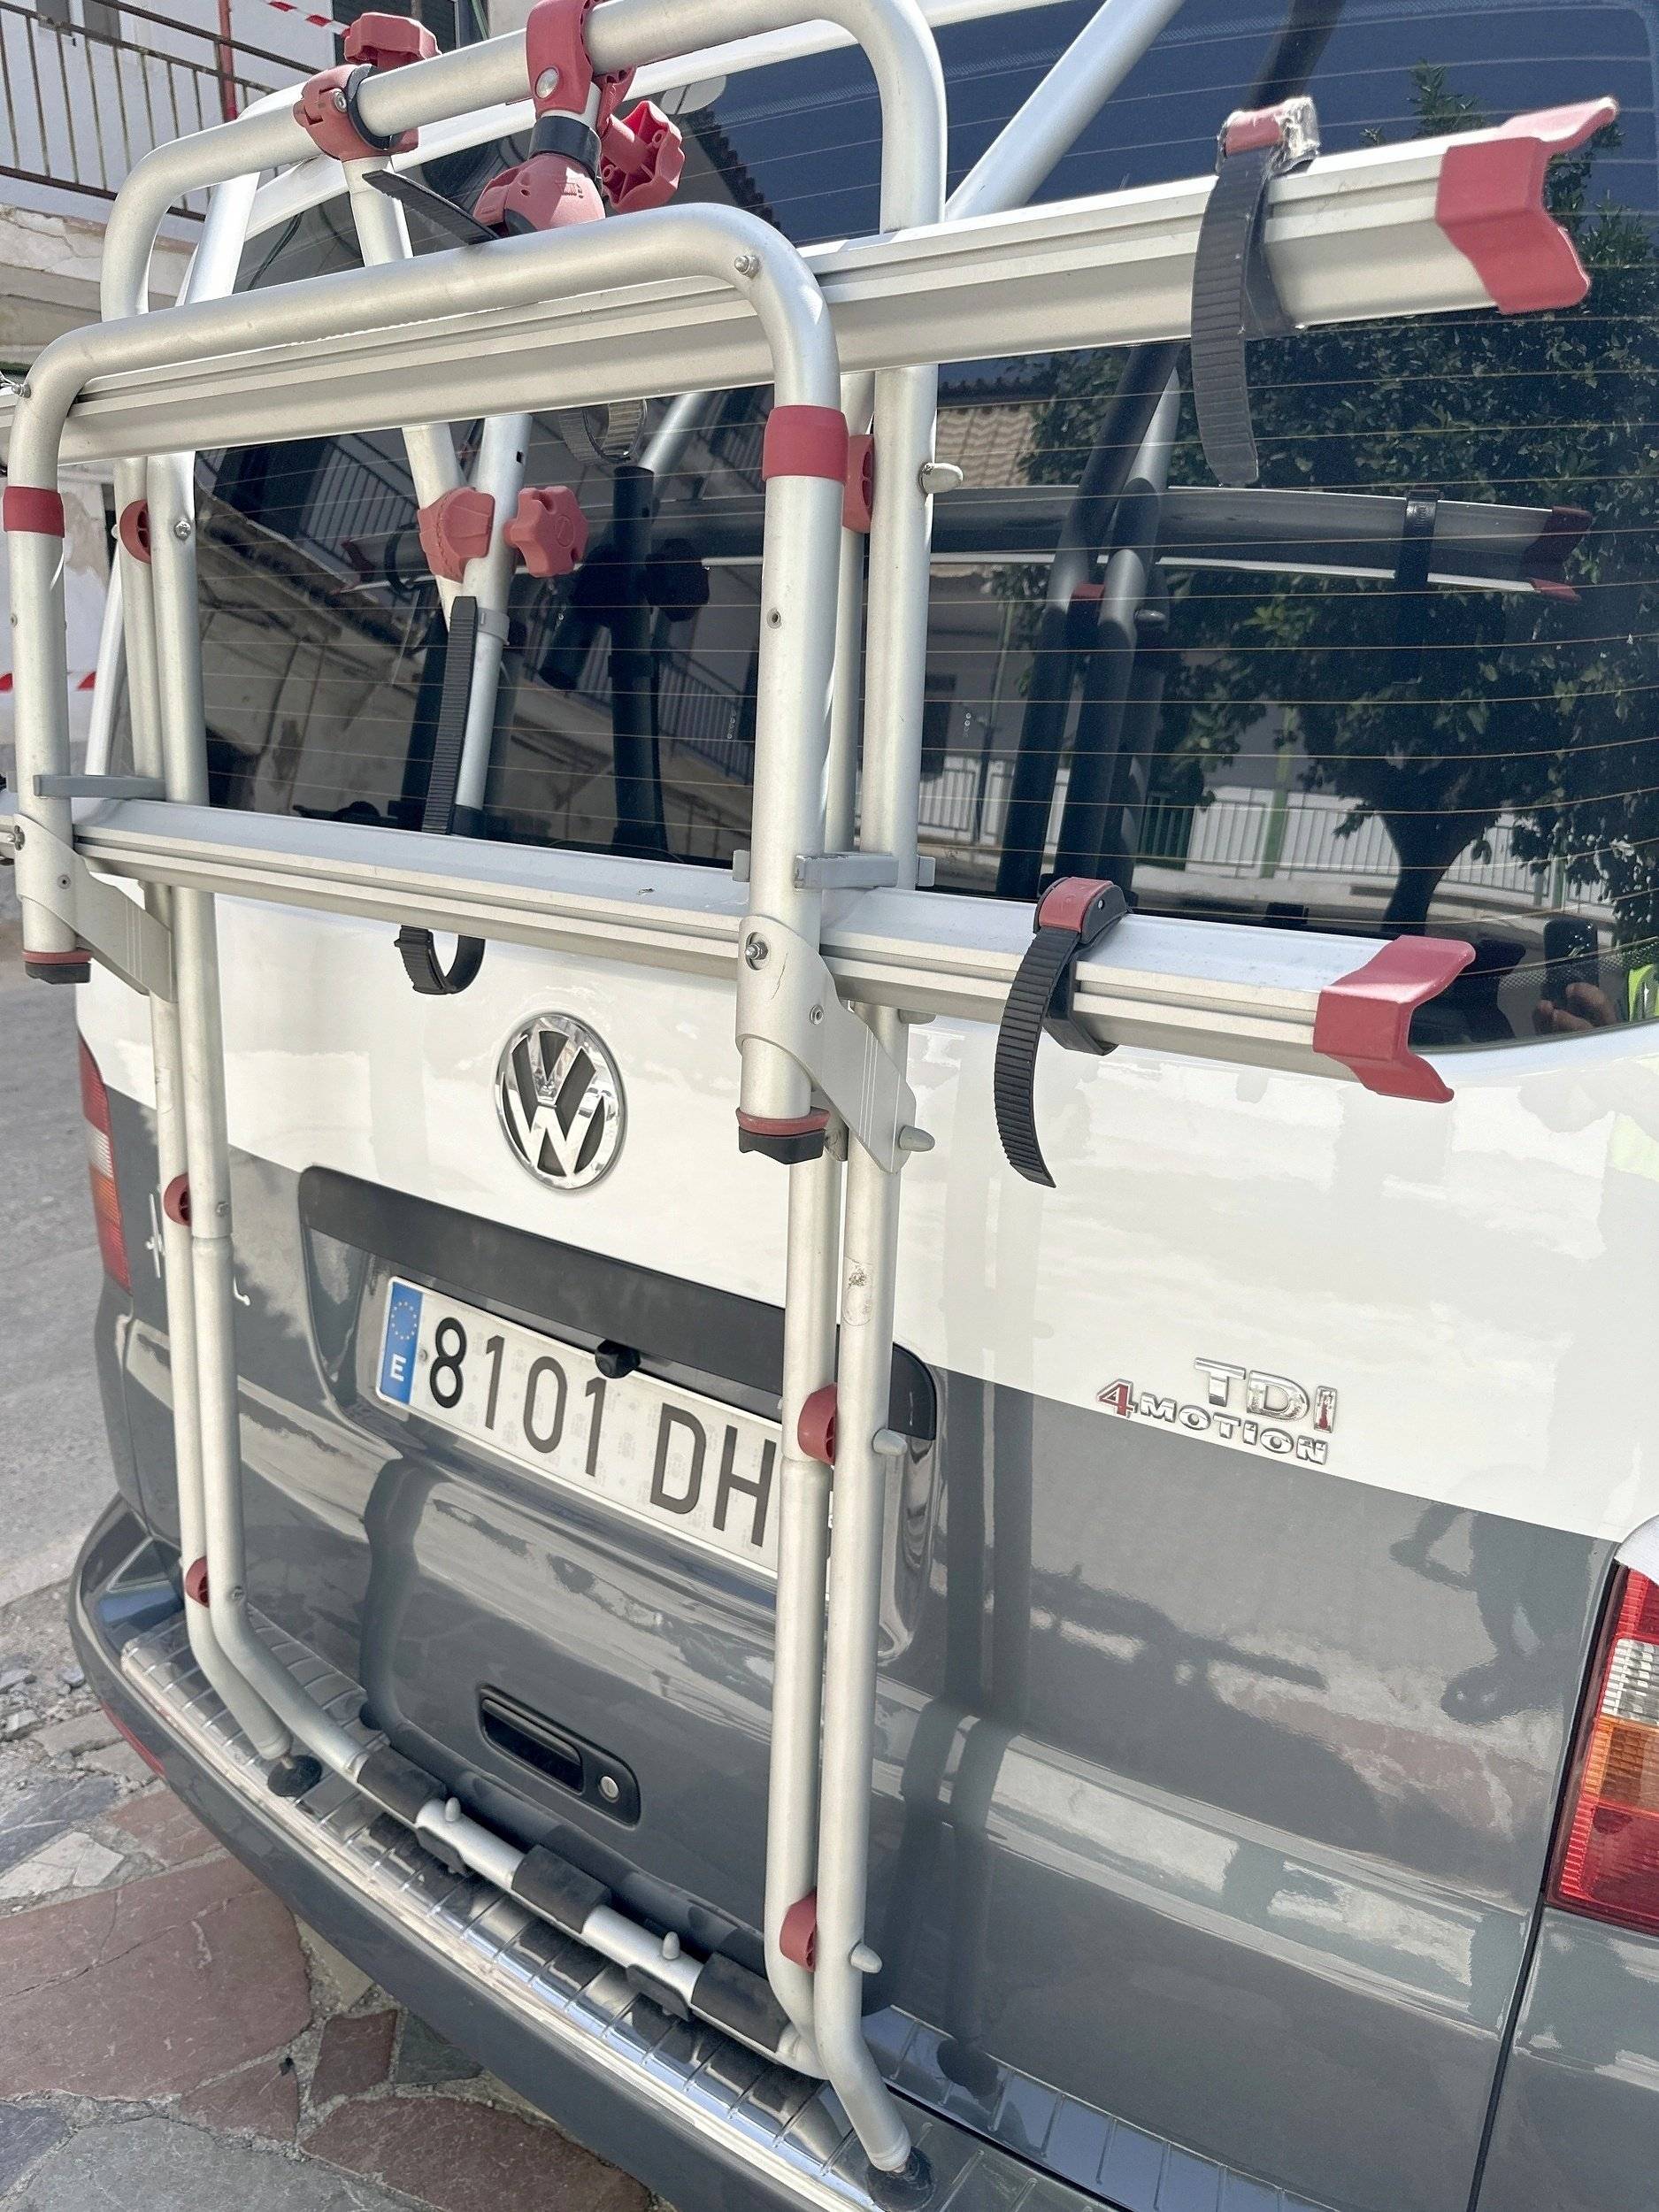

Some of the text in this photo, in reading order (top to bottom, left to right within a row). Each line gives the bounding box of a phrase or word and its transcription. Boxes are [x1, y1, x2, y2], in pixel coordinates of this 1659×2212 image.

[495, 1014, 626, 1189] VW
[389, 1353, 407, 1382] E
[1194, 1356, 1338, 1433] TDI
[429, 1317, 777, 1548] 8101 DH
[1096, 1378, 1327, 1465] 4MOTION
